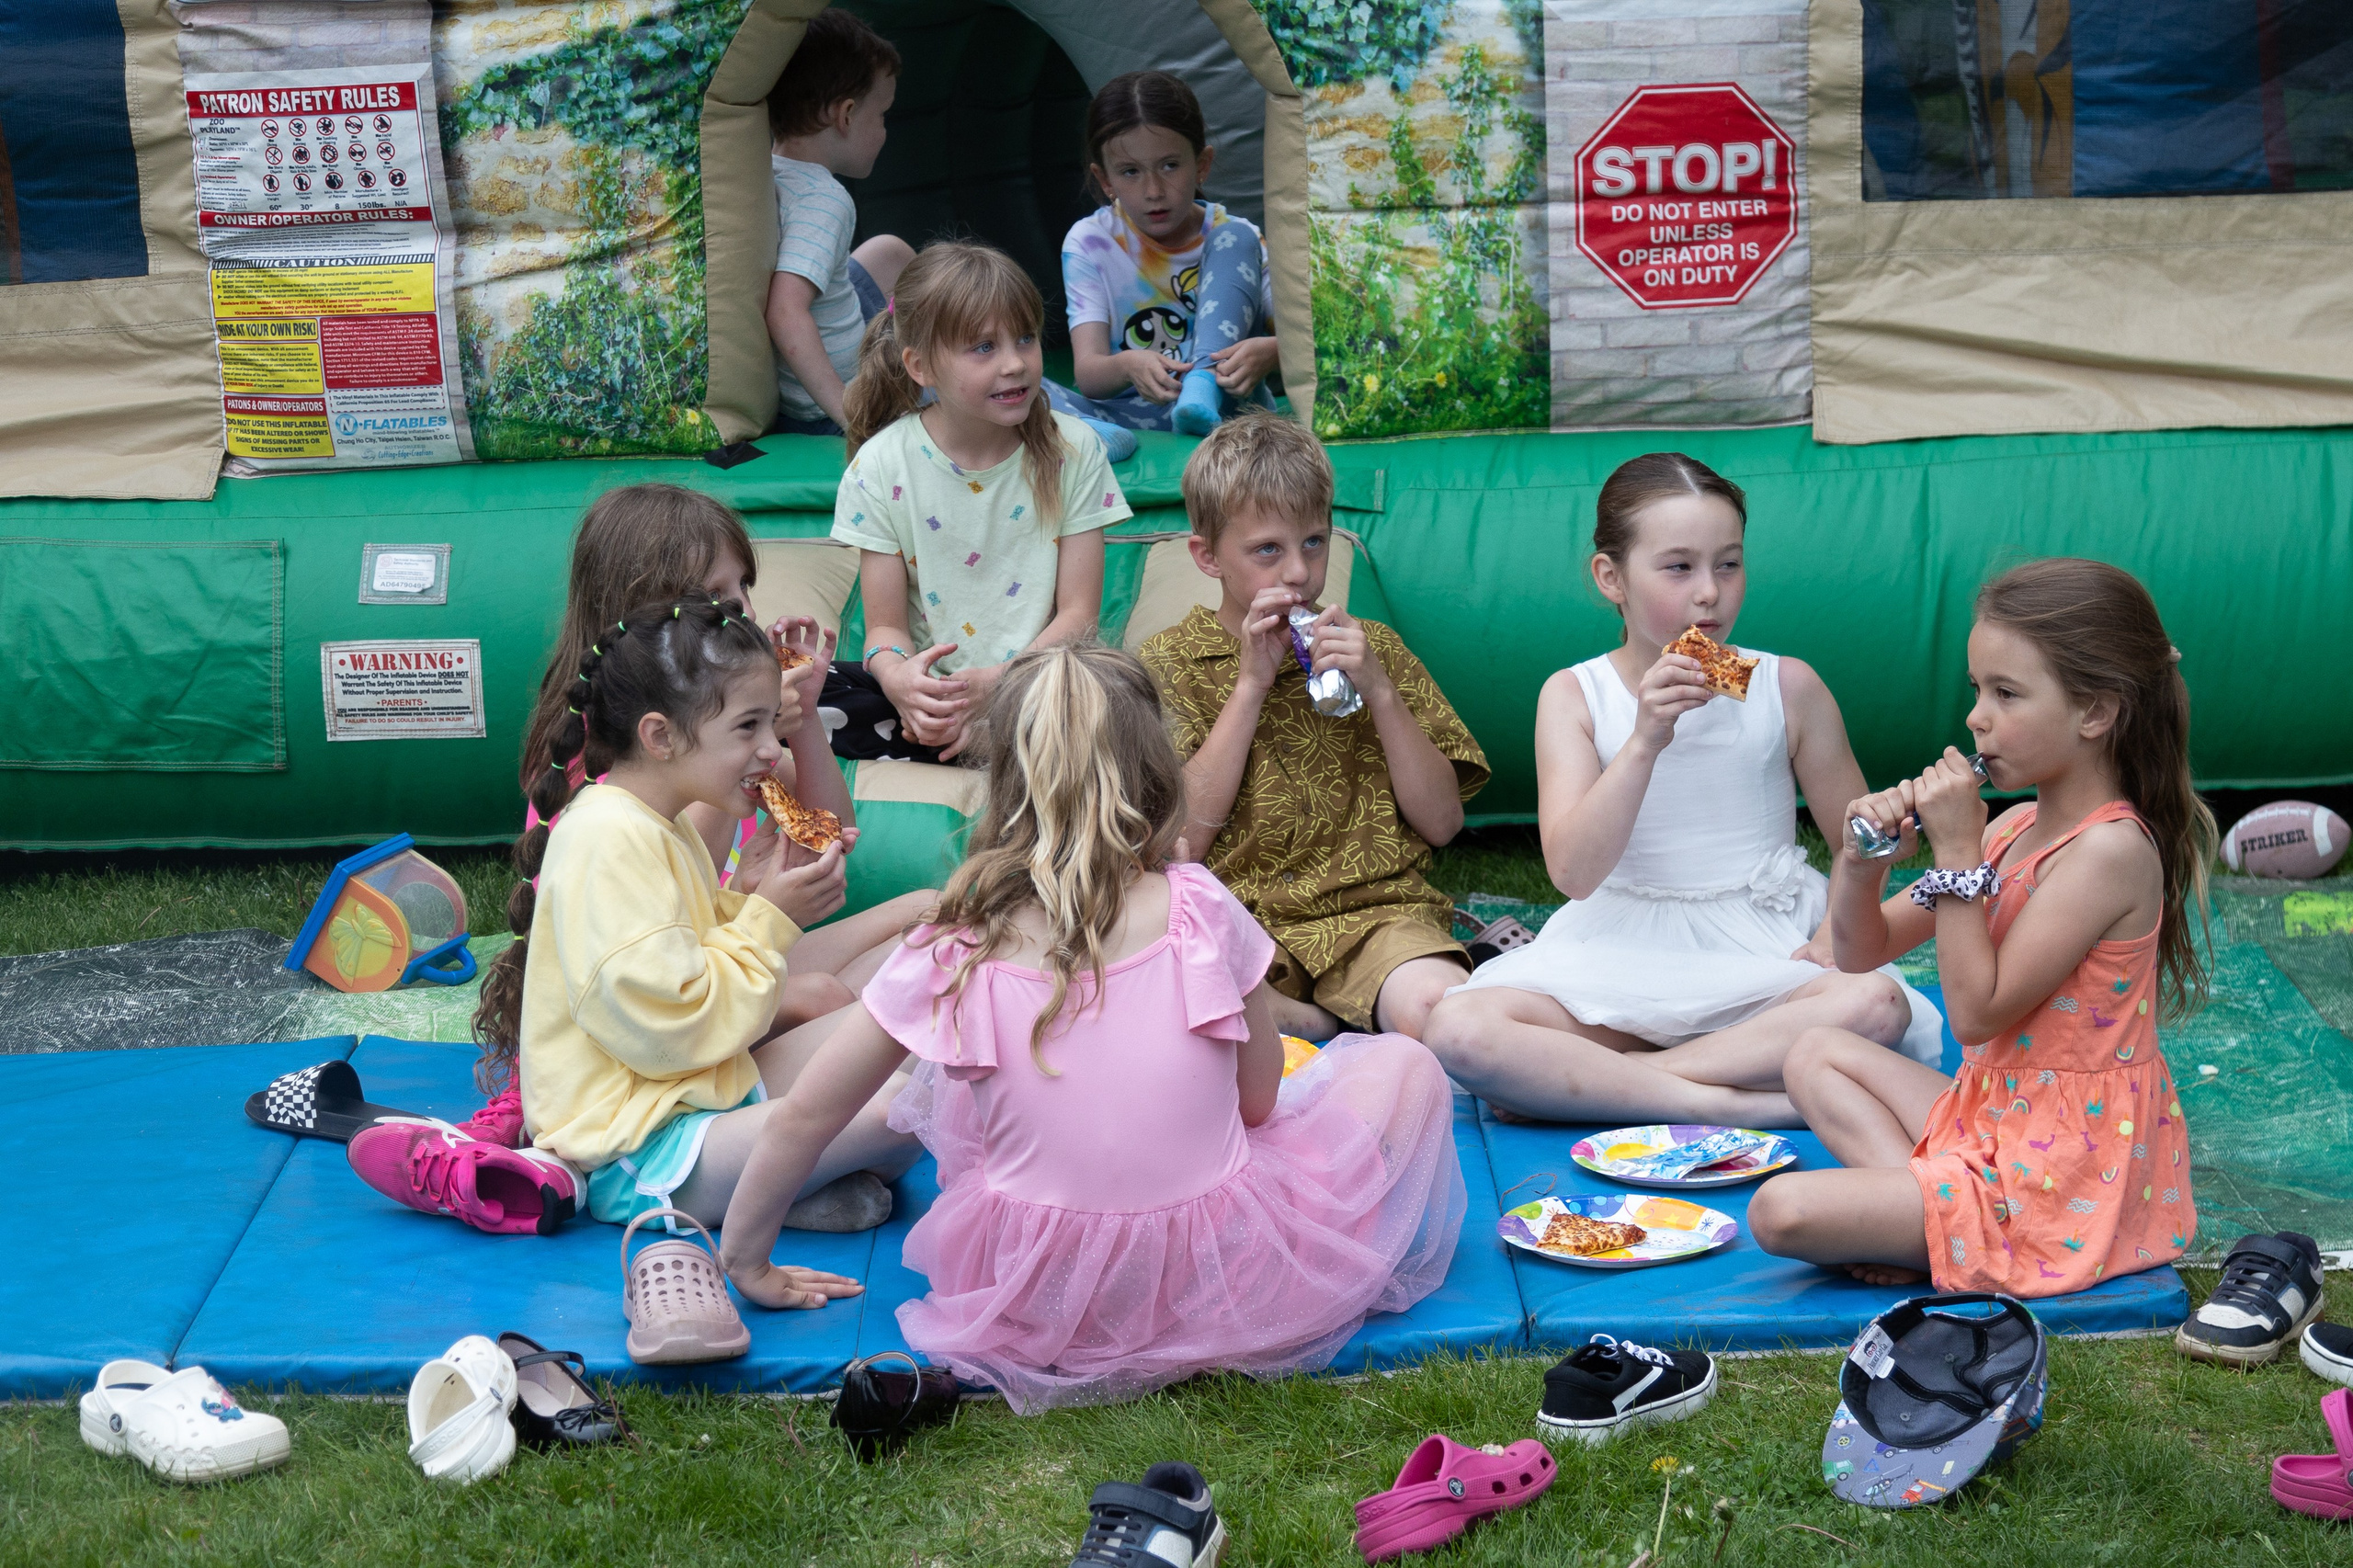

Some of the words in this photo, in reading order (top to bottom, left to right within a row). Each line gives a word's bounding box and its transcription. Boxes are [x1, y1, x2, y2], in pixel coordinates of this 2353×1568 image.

[199, 93, 264, 114] PATRON
[268, 89, 335, 112] SAFETY
[341, 86, 401, 109] RULES
[1592, 138, 1777, 198] STOP!
[214, 212, 355, 226] OWNER/OPERATOR
[358, 210, 414, 221] RULES:
[1611, 204, 1643, 222] DO
[1649, 202, 1692, 221] NOT
[1699, 199, 1768, 218] ENTER
[1650, 222, 1733, 244] UNLESS
[274, 257, 358, 267] CAUTION
[1618, 244, 1733, 267] OPERATOR
[1740, 242, 1760, 260] IS
[1643, 268, 1675, 287] ON
[1681, 265, 1738, 284] DUTY
[218, 324, 236, 336] RIDE
[236, 324, 245, 336] AT
[246, 323, 268, 336] YOUR
[270, 323, 291, 336] OWN
[293, 323, 316, 335] RISK!
[227, 399, 251, 410] PATONS
[252, 400, 257, 410] &
[257, 401, 324, 412] OWNER/OPERATORS
[349, 652, 453, 671] WARNING
[345, 672, 370, 681] Designer
[2241, 828, 2308, 855] STRIKER
[1356, 1504, 1386, 1519] rocs
